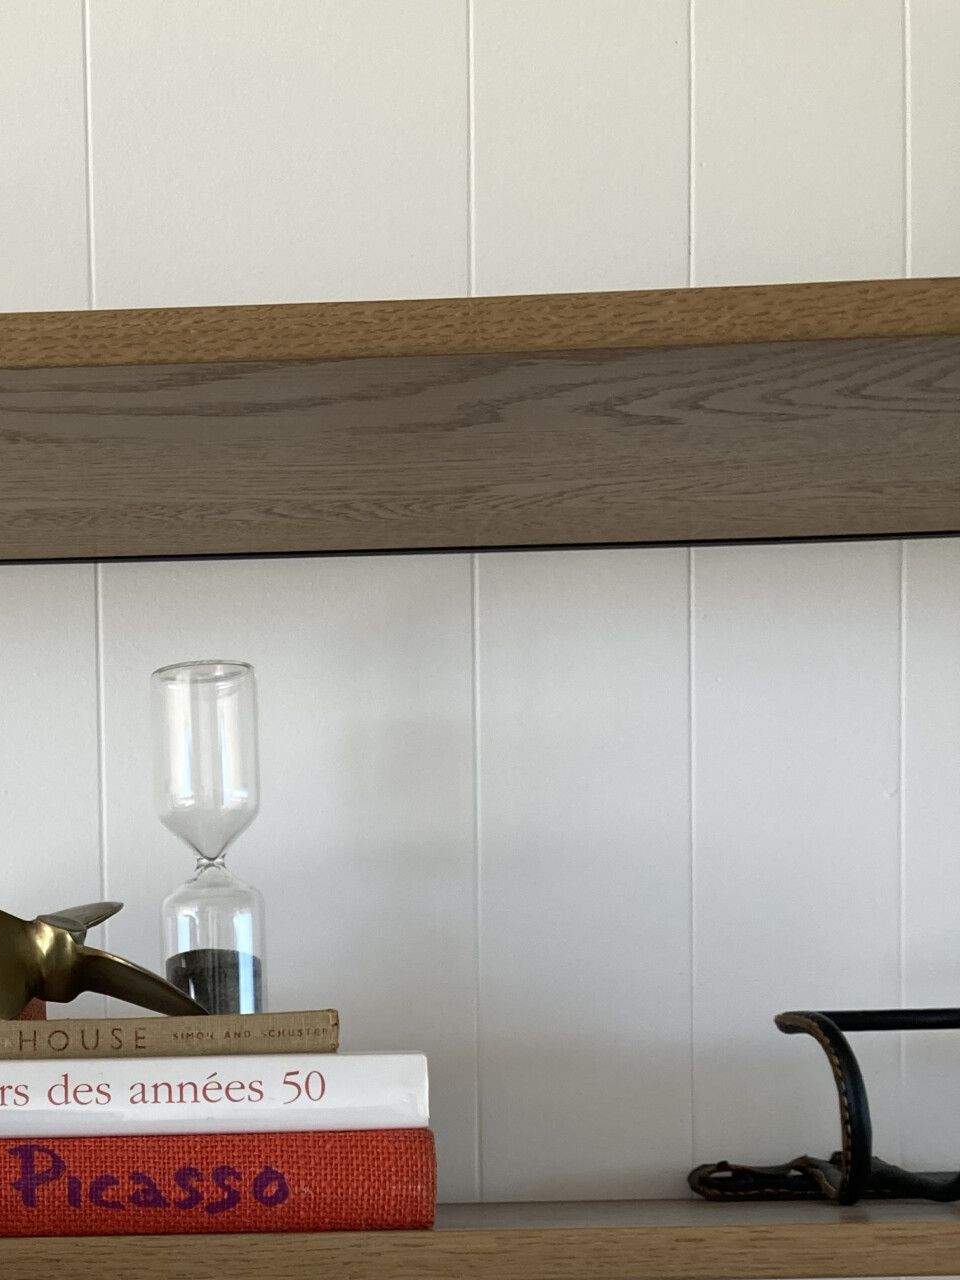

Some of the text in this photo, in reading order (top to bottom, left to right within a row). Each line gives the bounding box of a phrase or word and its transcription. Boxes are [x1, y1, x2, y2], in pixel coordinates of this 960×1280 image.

[19, 1028, 147, 1052] HOUSE
[224, 1030, 252, 1039] AND
[47, 1073, 112, 1106] des
[129, 1072, 264, 1105] années
[283, 1070, 326, 1105] 50
[8, 1144, 292, 1214] Picasso
